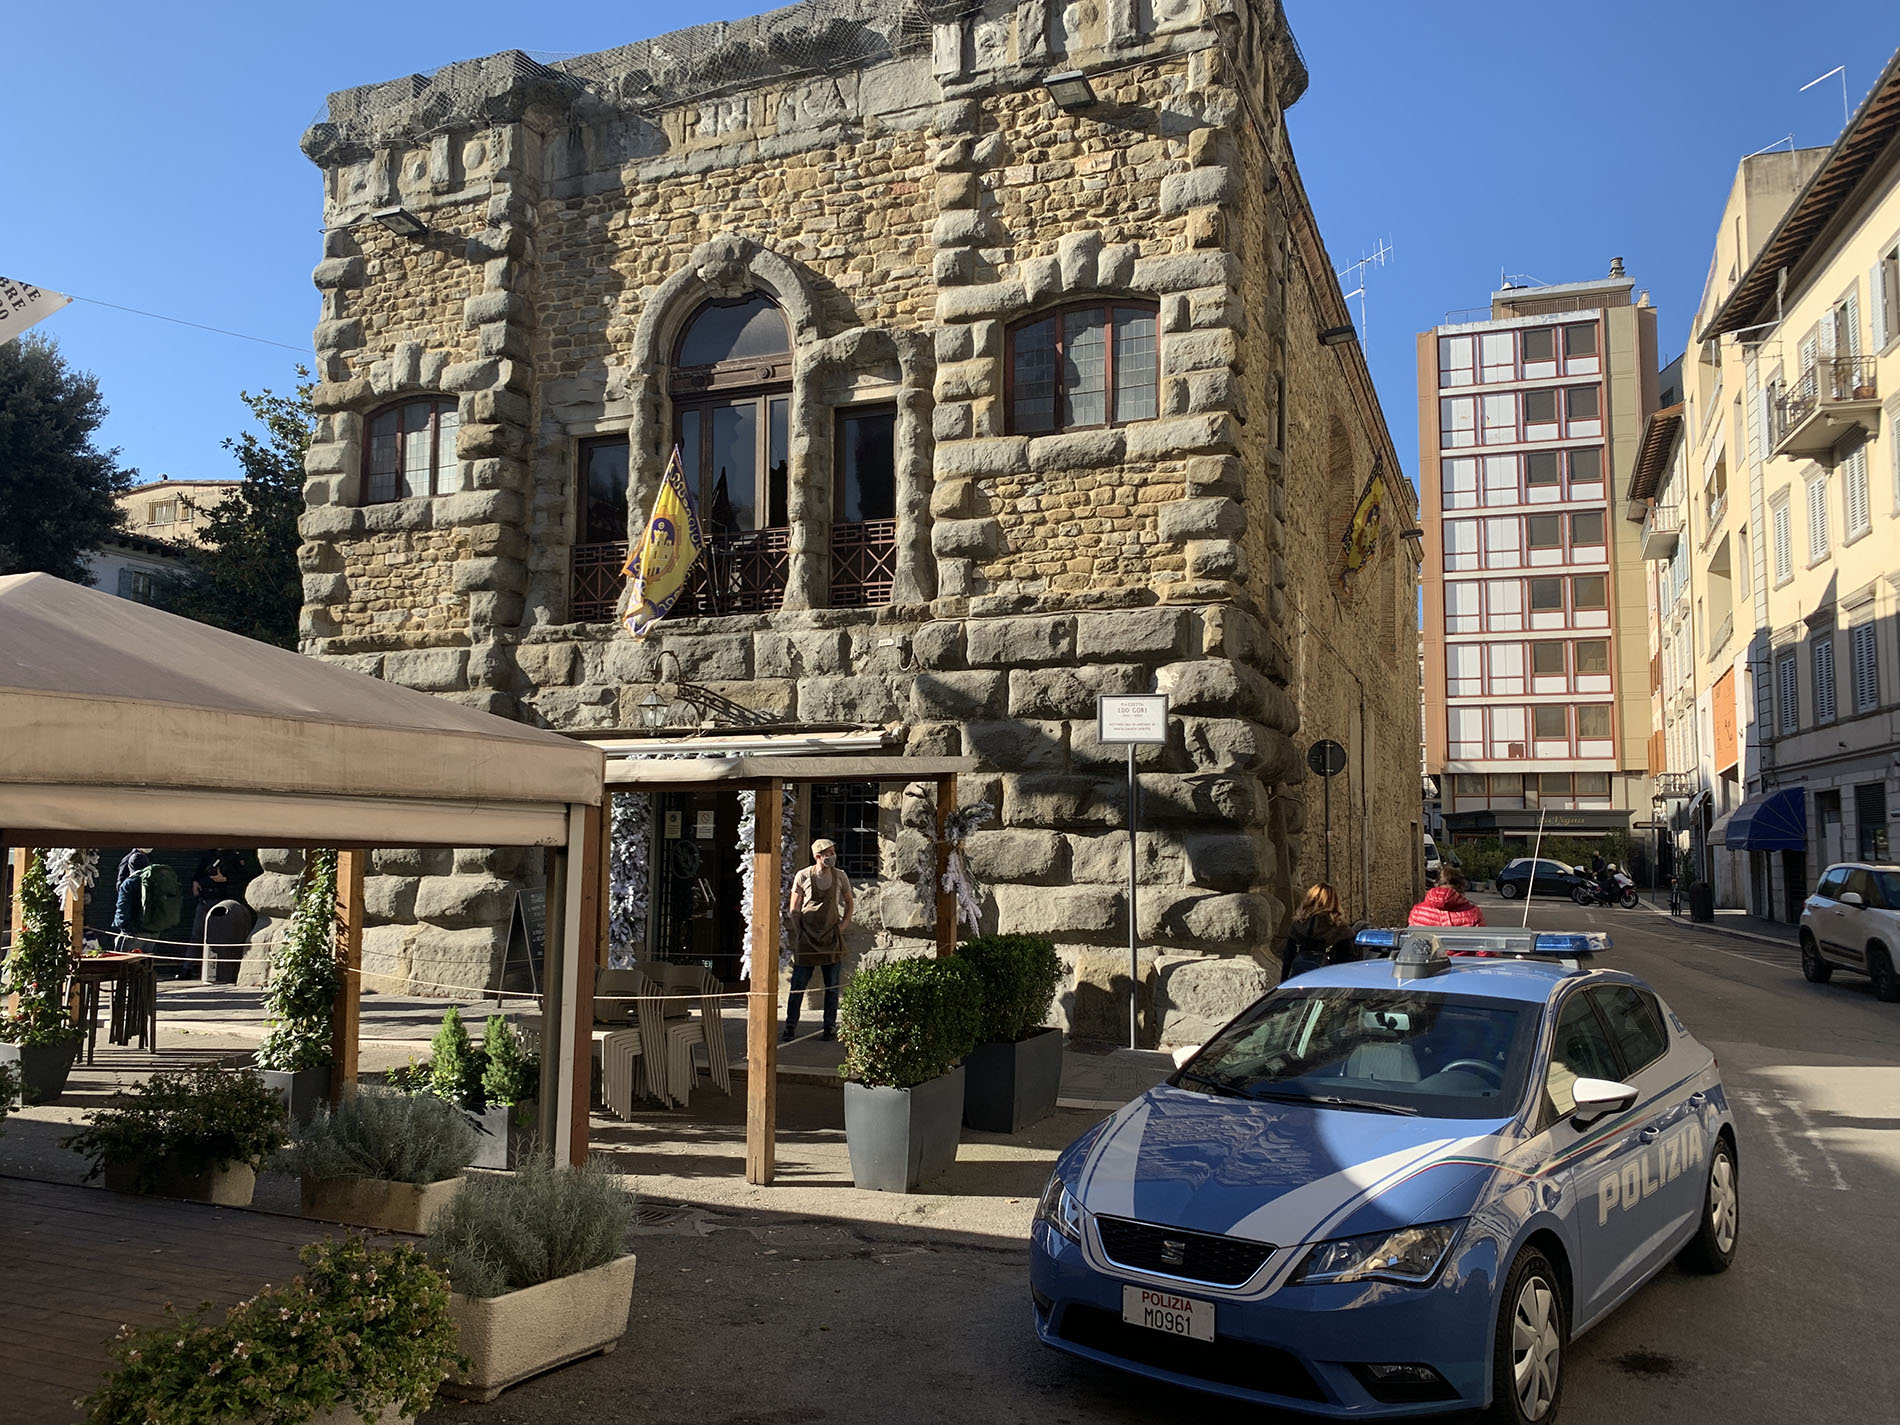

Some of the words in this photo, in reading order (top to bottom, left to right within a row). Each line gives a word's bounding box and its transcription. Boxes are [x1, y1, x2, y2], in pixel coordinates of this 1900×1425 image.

[1599, 1121, 1704, 1227] POLIZIA
[1142, 1290, 1193, 1313] POLIZIA
[1144, 1307, 1191, 1336] M0961
